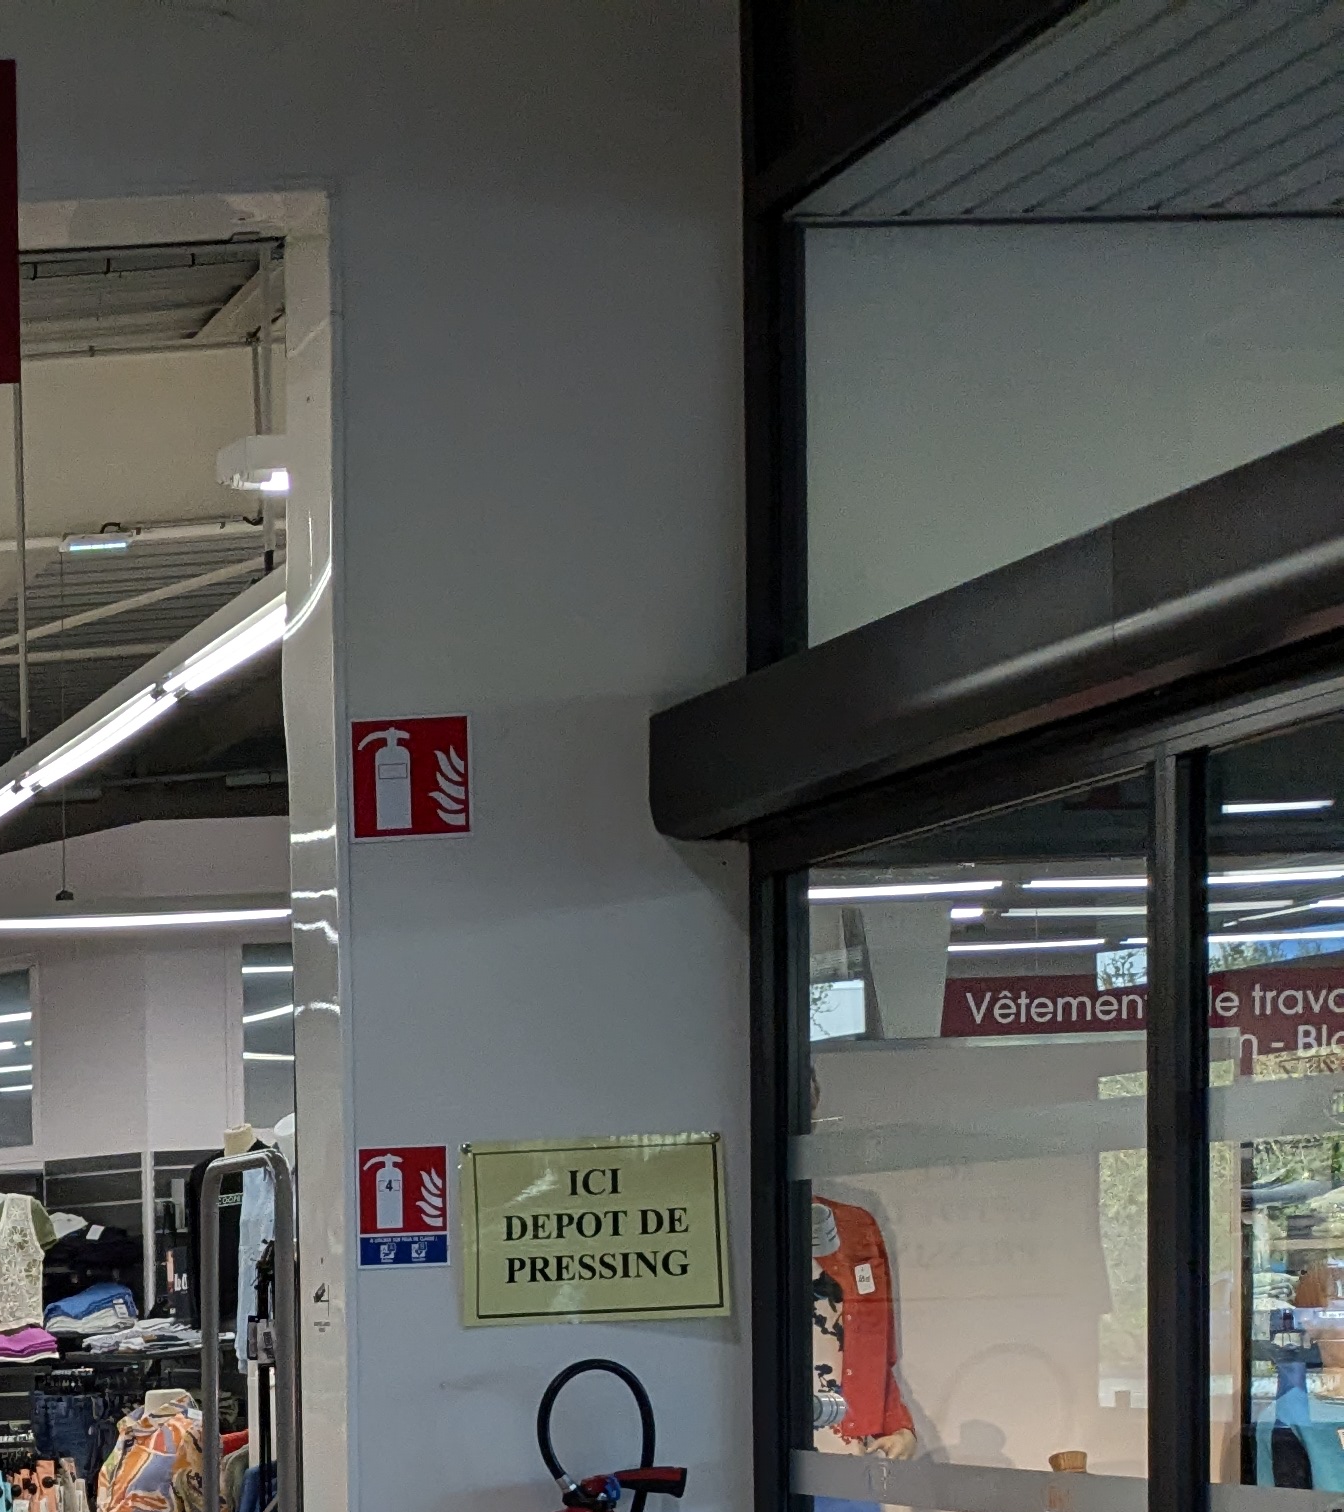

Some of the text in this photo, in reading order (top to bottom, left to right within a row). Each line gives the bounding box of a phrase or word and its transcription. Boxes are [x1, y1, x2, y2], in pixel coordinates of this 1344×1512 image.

[966, 990, 1147, 1024] Vêtemen
[385, 1180, 393, 1192] 4
[568, 1168, 621, 1196] ICI
[503, 1207, 689, 1242] DEPOT DE
[505, 1249, 690, 1284] PRESSING
